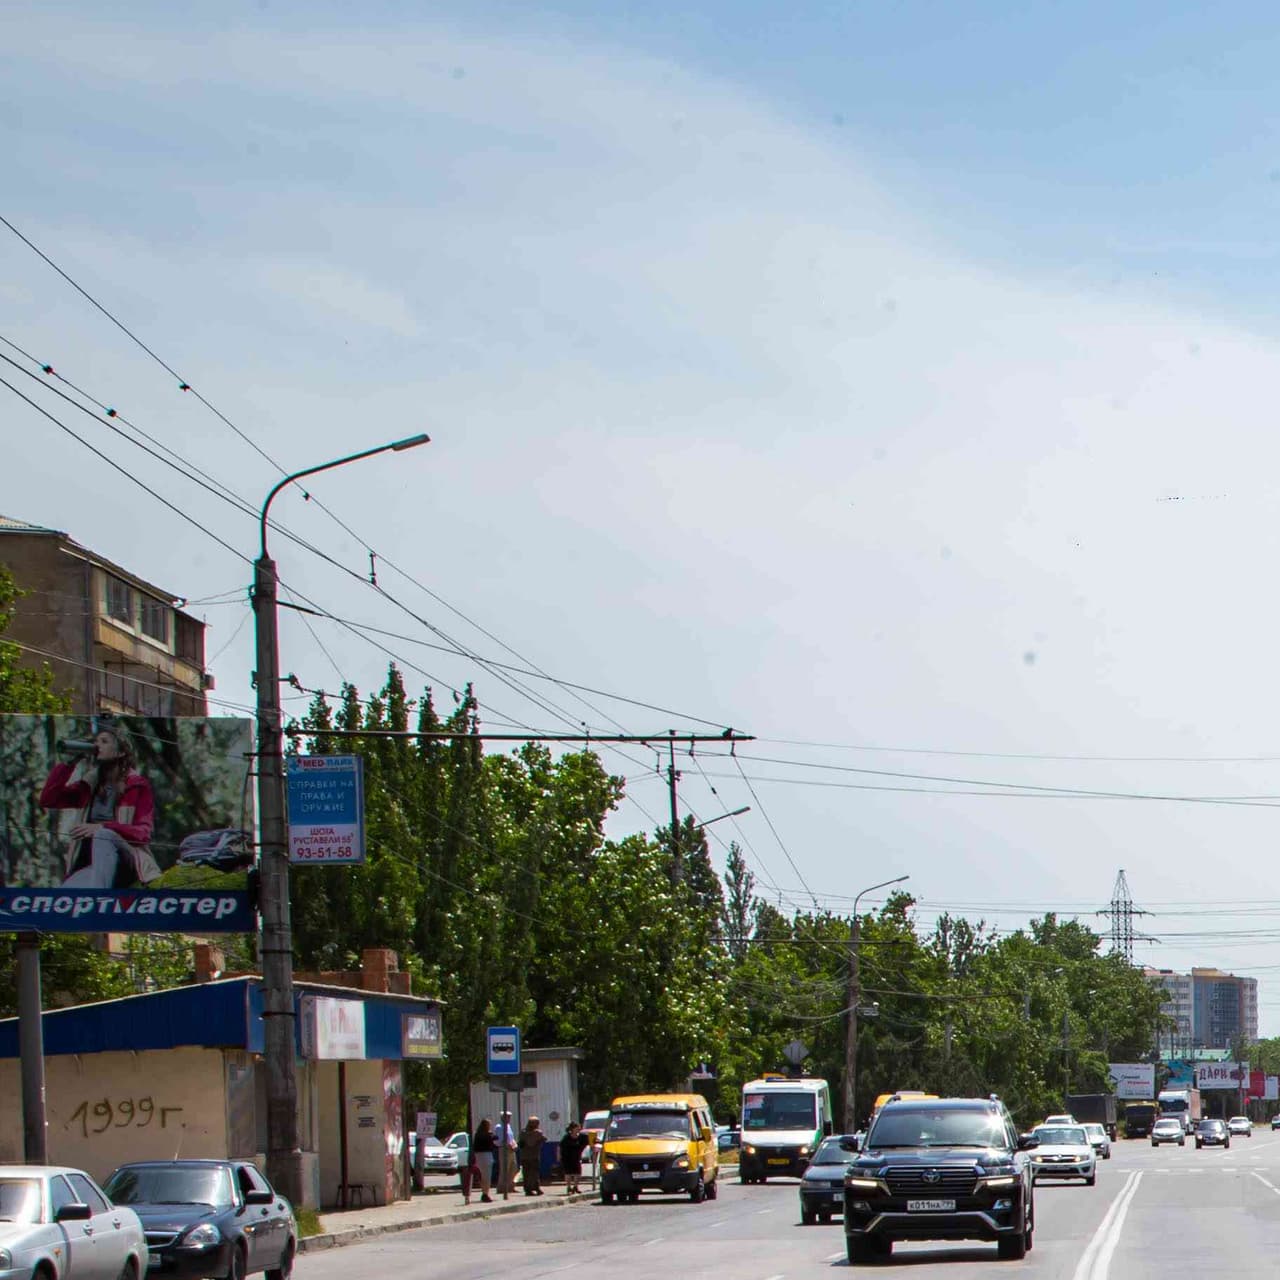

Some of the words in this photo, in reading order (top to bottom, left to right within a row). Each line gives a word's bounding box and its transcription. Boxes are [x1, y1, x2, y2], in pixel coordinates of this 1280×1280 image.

[289, 780, 337, 789] СПРАВКИ
[341, 780, 354, 788] НА
[300, 792, 333, 801] ПРАВА
[336, 791, 345, 800] И
[301, 802, 345, 812] ОРУЖИЕ
[310, 827, 335, 835] ШОТА
[293, 836, 340, 845] РУСТАВЕЛИ
[297, 847, 352, 859] 93-51-58
[11, 895, 238, 918] спортмастер
